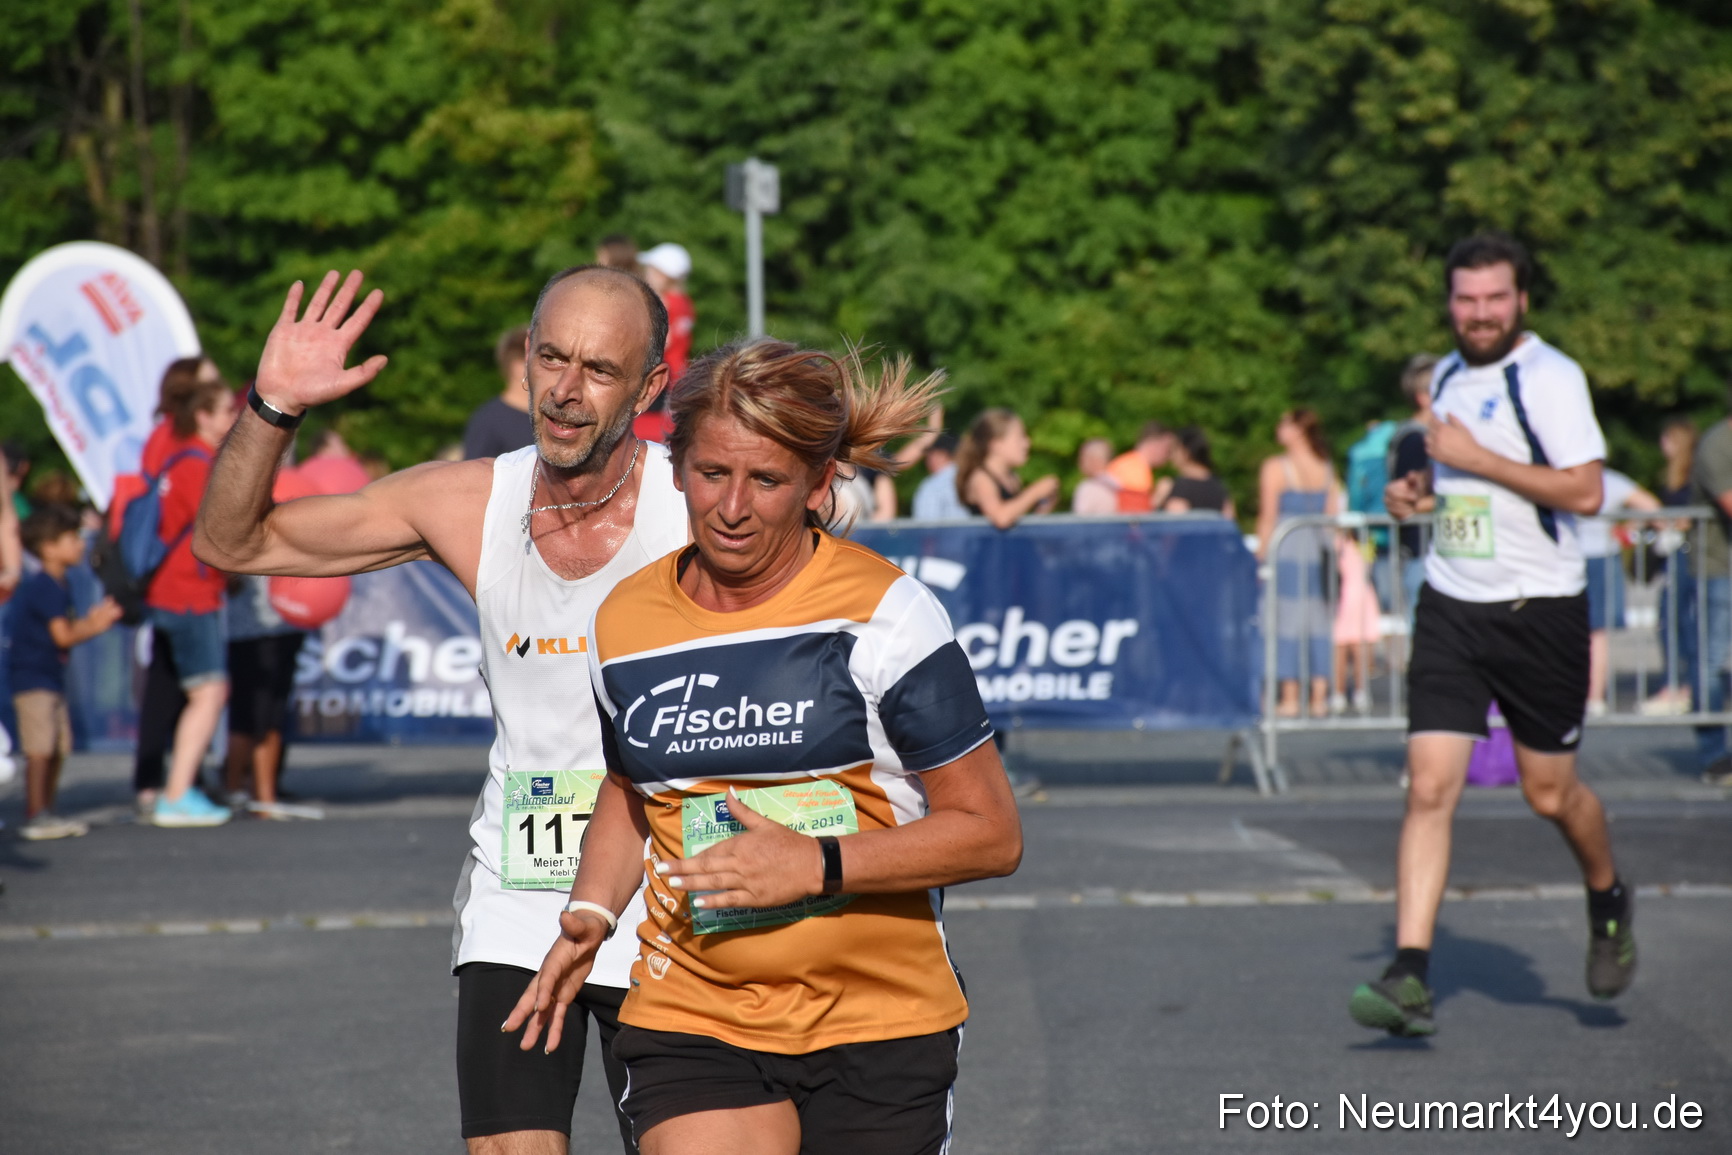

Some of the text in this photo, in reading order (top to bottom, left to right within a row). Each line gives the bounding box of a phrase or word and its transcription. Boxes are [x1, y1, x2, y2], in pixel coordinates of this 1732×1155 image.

[650, 695, 814, 738] Fischer
[665, 730, 803, 755] AUTOMOBILE
[521, 792, 576, 806] firmenlauf
[811, 814, 843, 830] 2019
[533, 857, 564, 868] Meier
[549, 869, 570, 877] Klebl
[650, 906, 666, 919] Audi
[715, 908, 748, 918] Fischer
